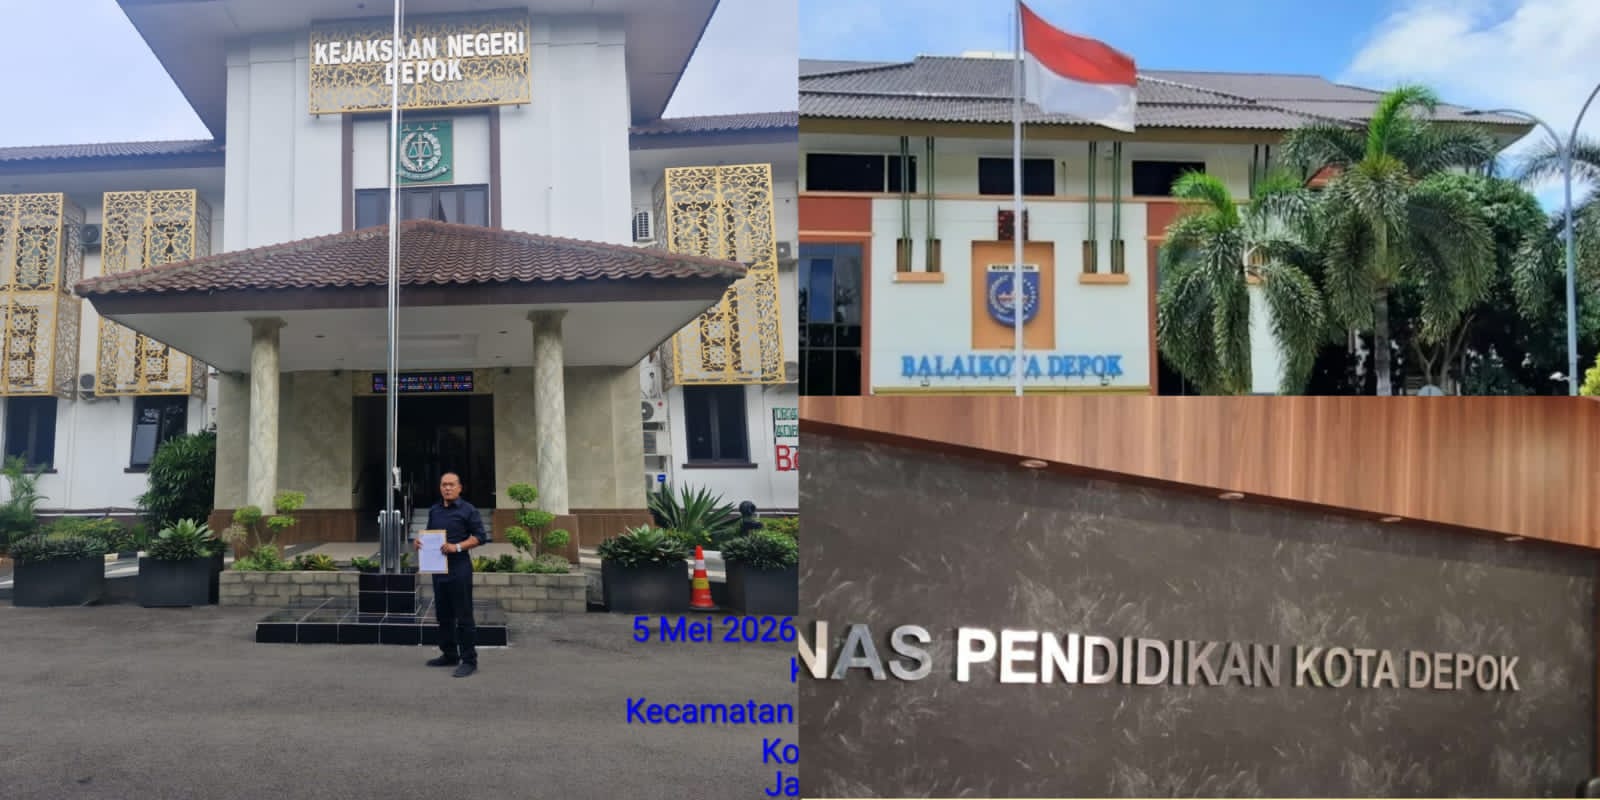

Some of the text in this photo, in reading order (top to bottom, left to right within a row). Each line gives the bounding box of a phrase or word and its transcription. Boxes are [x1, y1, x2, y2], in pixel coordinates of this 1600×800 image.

[447, 31, 525, 58] NEGERI
[385, 58, 463, 85] DEPOK
[901, 354, 1123, 378] BALAIKOA DEPOK
[798, 621, 933, 681] NAS
[956, 626, 1281, 687] PENDIDIKAN
[1296, 645, 1399, 689] KOTA
[1408, 650, 1520, 692] DEPOK
